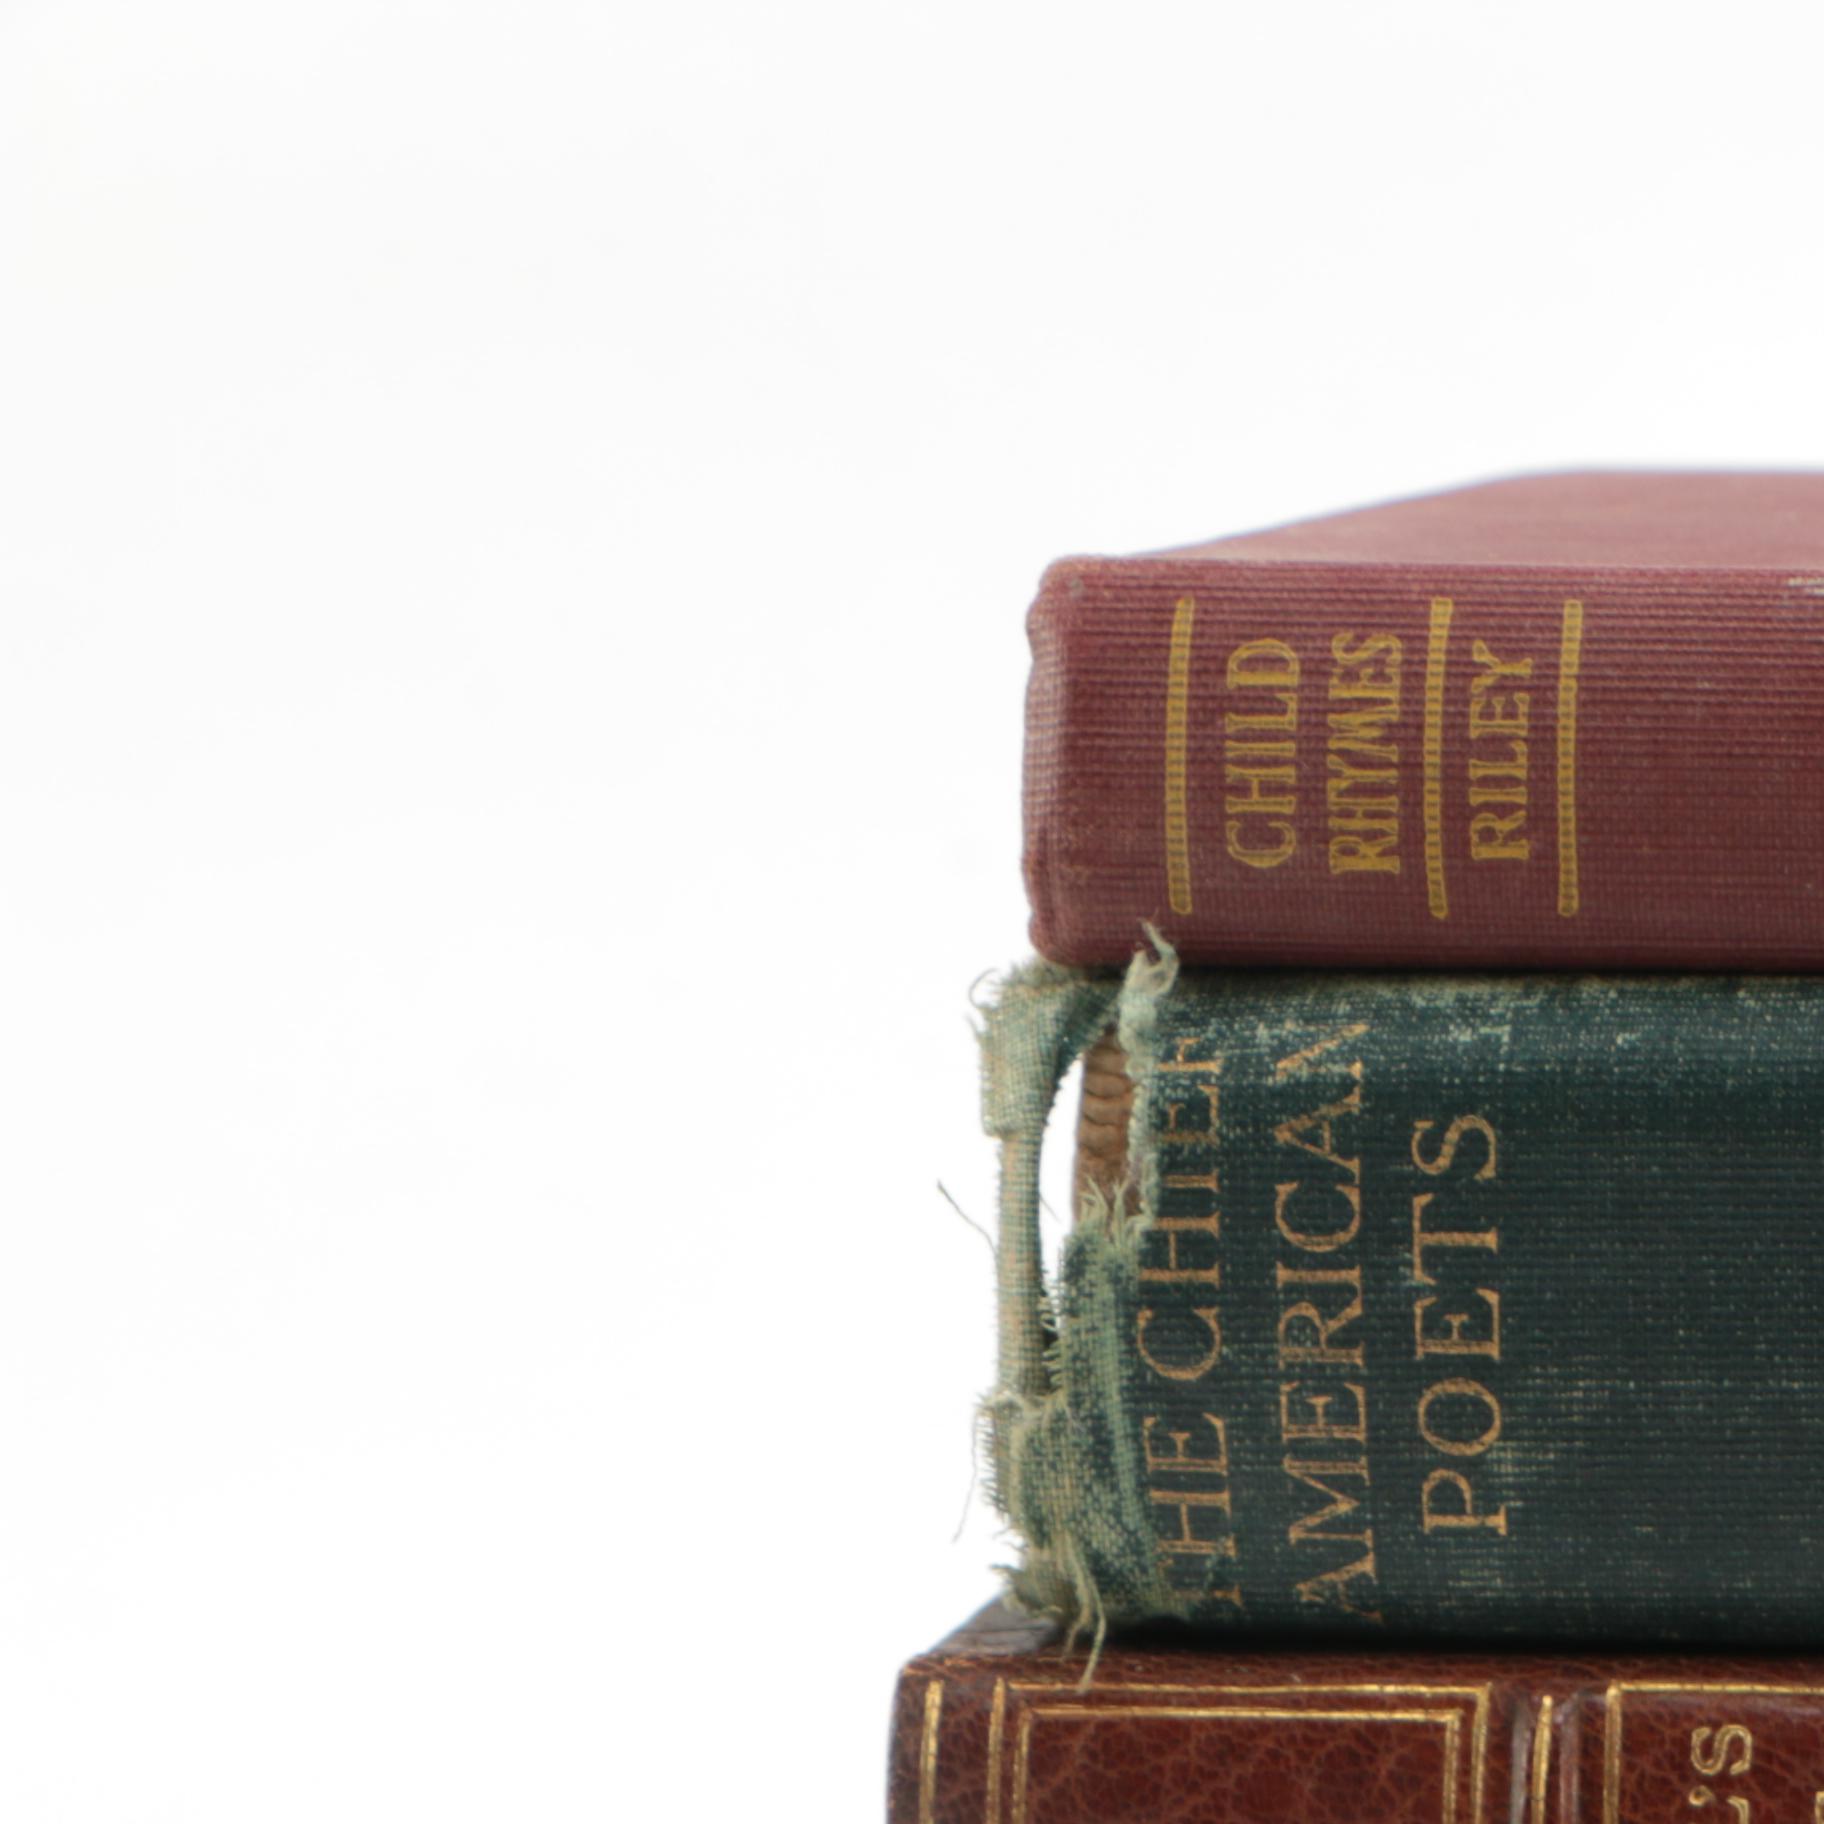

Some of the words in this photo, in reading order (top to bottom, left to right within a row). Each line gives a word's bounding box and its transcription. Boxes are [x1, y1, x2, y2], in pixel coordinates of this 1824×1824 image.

[1225, 638, 1300, 868] CHILD
[1327, 632, 1401, 875] RHYMES
[1469, 639, 1532, 860] RILEY
[1276, 1022, 1383, 1624] AMERICAN
[1411, 1115, 1508, 1536] POETS
